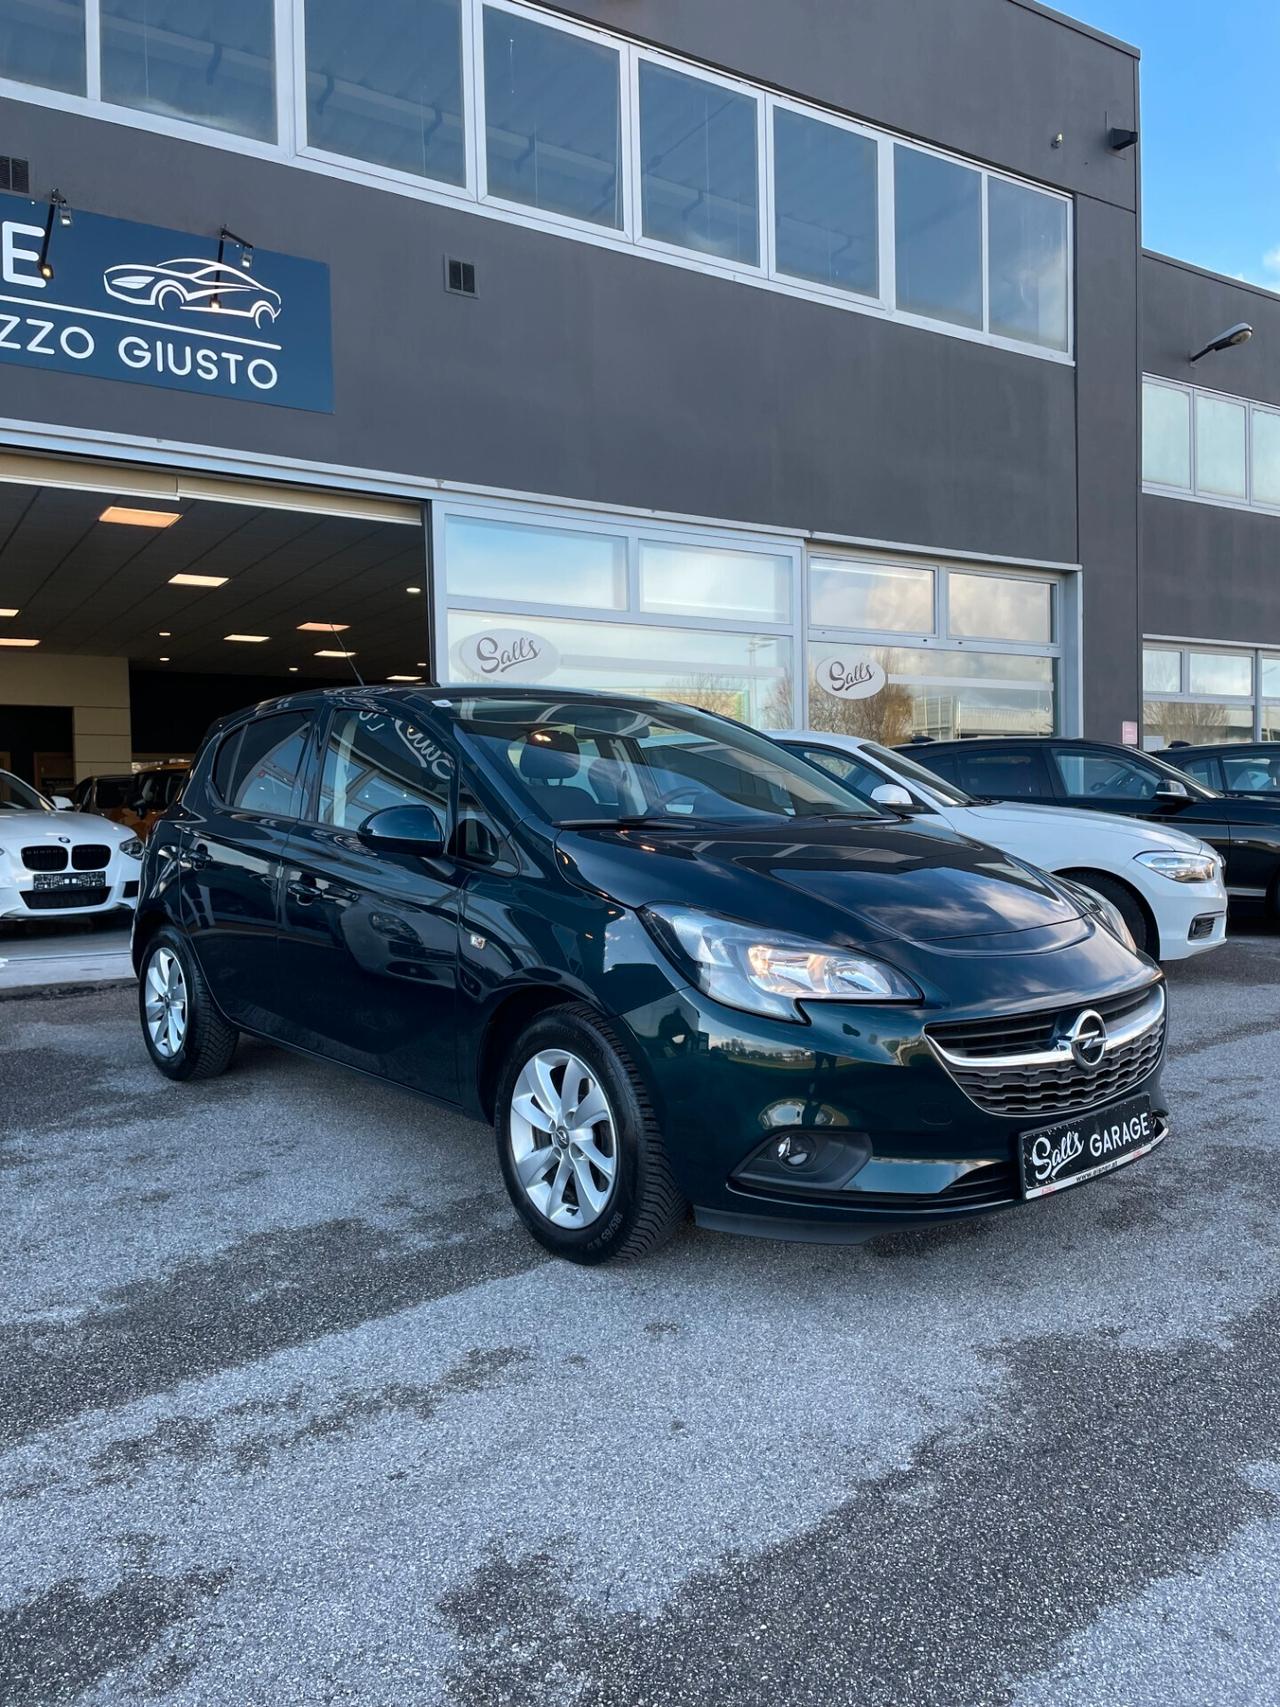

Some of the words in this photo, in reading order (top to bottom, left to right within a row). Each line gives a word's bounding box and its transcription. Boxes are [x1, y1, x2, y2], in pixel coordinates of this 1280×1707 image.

[2, 220, 46, 288] E
[118, 336, 278, 390] GIUSTO
[1089, 1112, 1151, 1157] GARAGE
